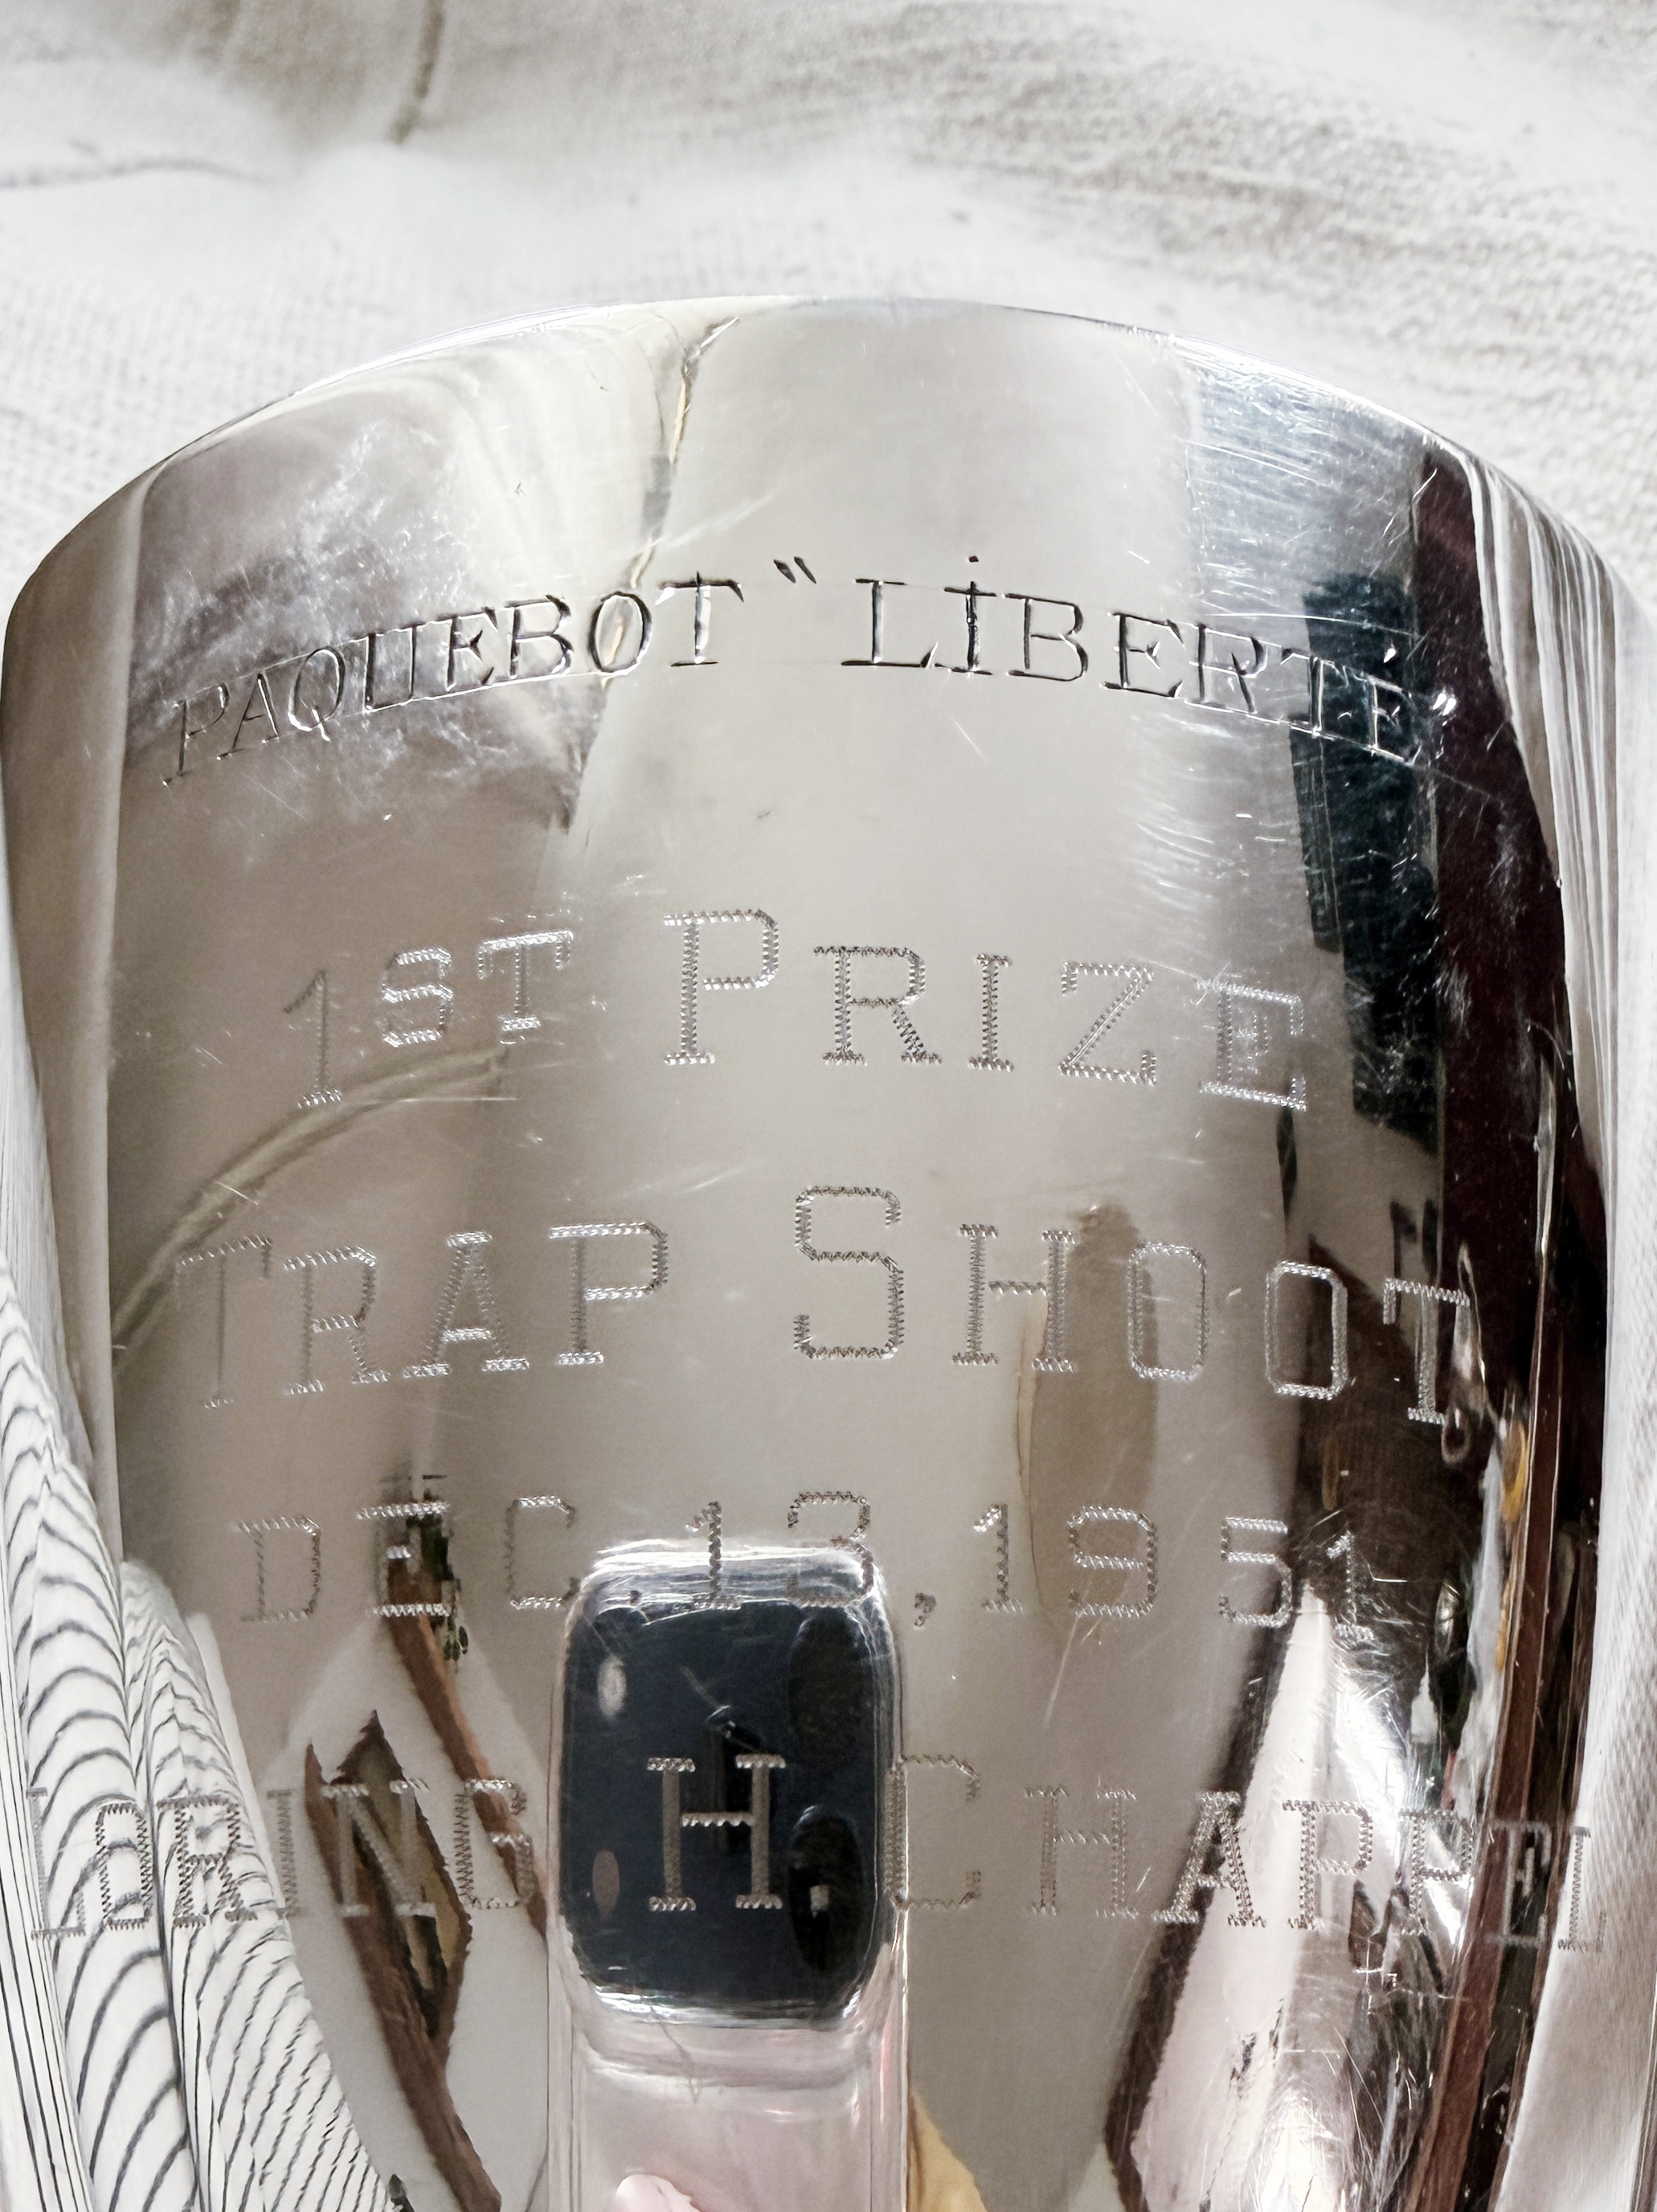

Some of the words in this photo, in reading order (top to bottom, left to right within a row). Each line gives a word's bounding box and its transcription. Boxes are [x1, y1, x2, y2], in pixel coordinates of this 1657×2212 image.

[163, 571, 744, 787] PAQUEBOT
[663, 908, 1307, 1112] PRIZE
[174, 1220, 669, 1408] TRAP
[795, 1185, 1471, 1425] SHOOT
